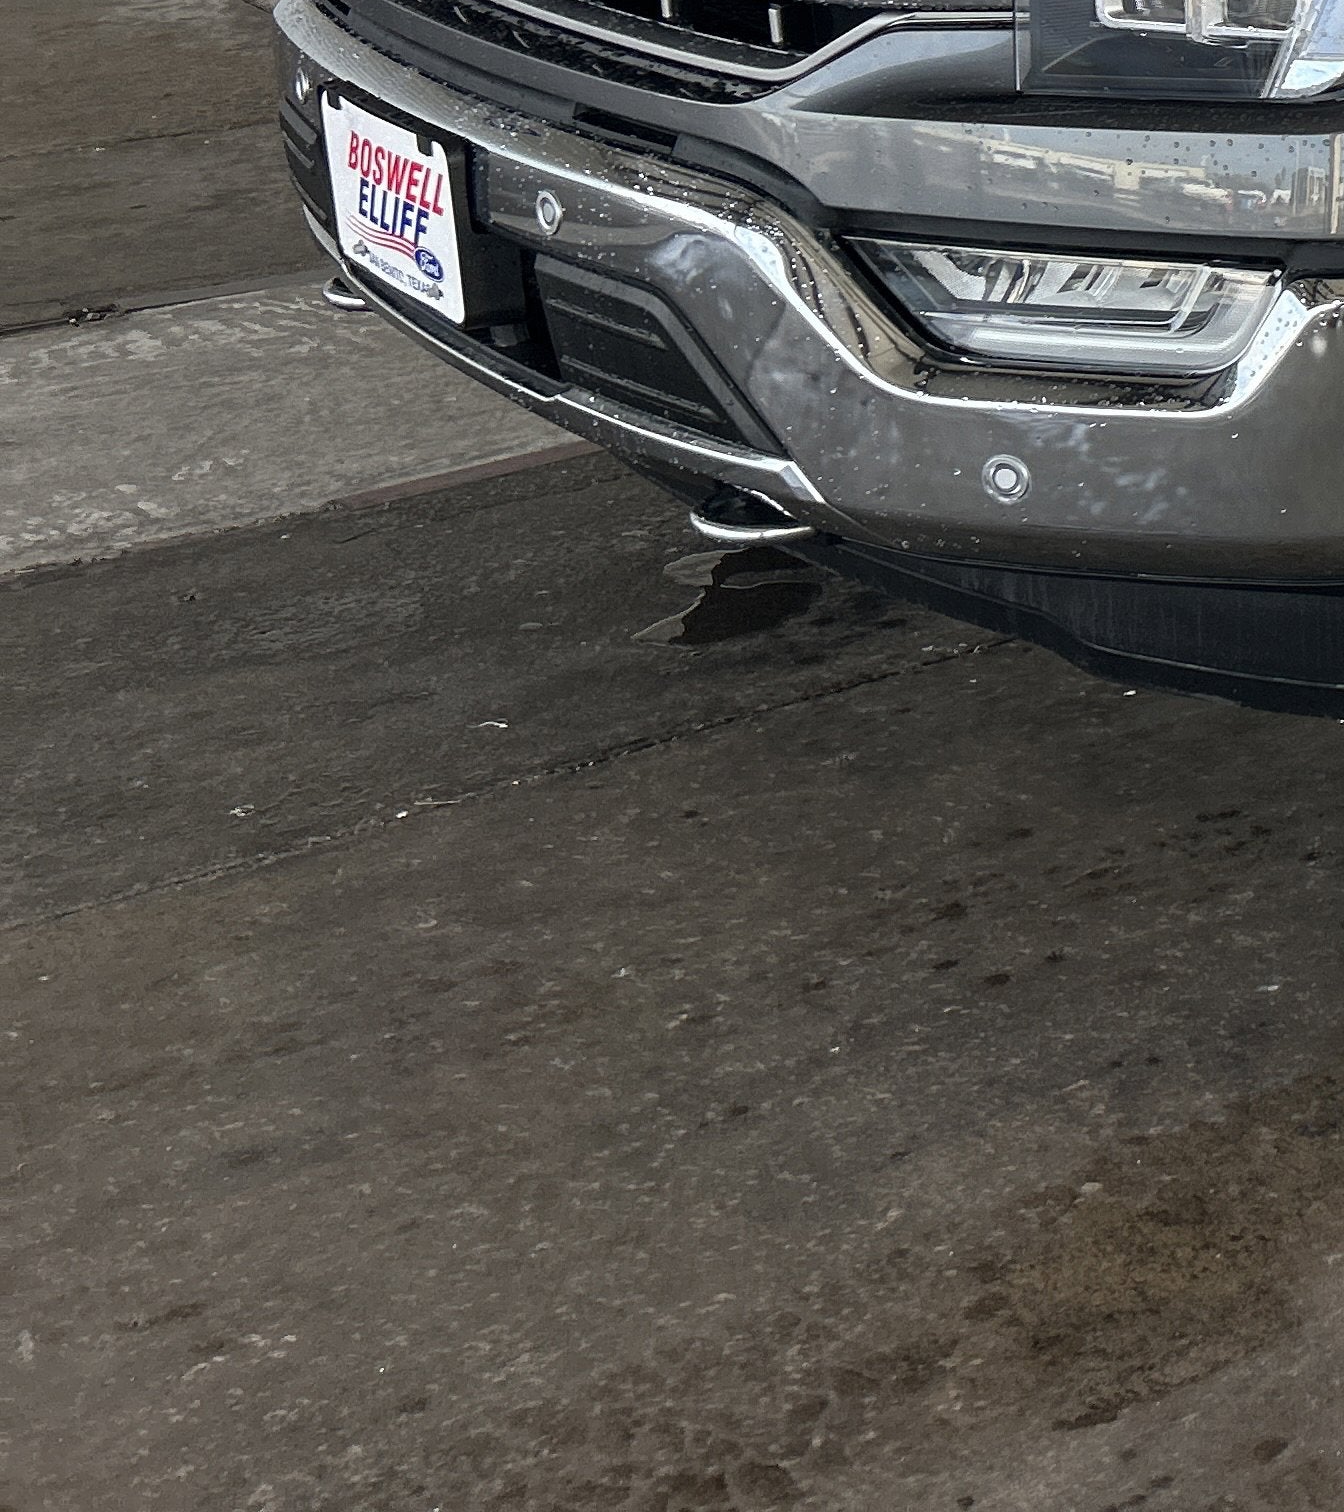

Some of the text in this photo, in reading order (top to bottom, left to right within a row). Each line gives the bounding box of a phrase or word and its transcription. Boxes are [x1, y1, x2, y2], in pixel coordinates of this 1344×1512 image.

[347, 129, 445, 217] BOSWELL
[358, 177, 430, 247] ELLIFF
[418, 249, 442, 279] Ford
